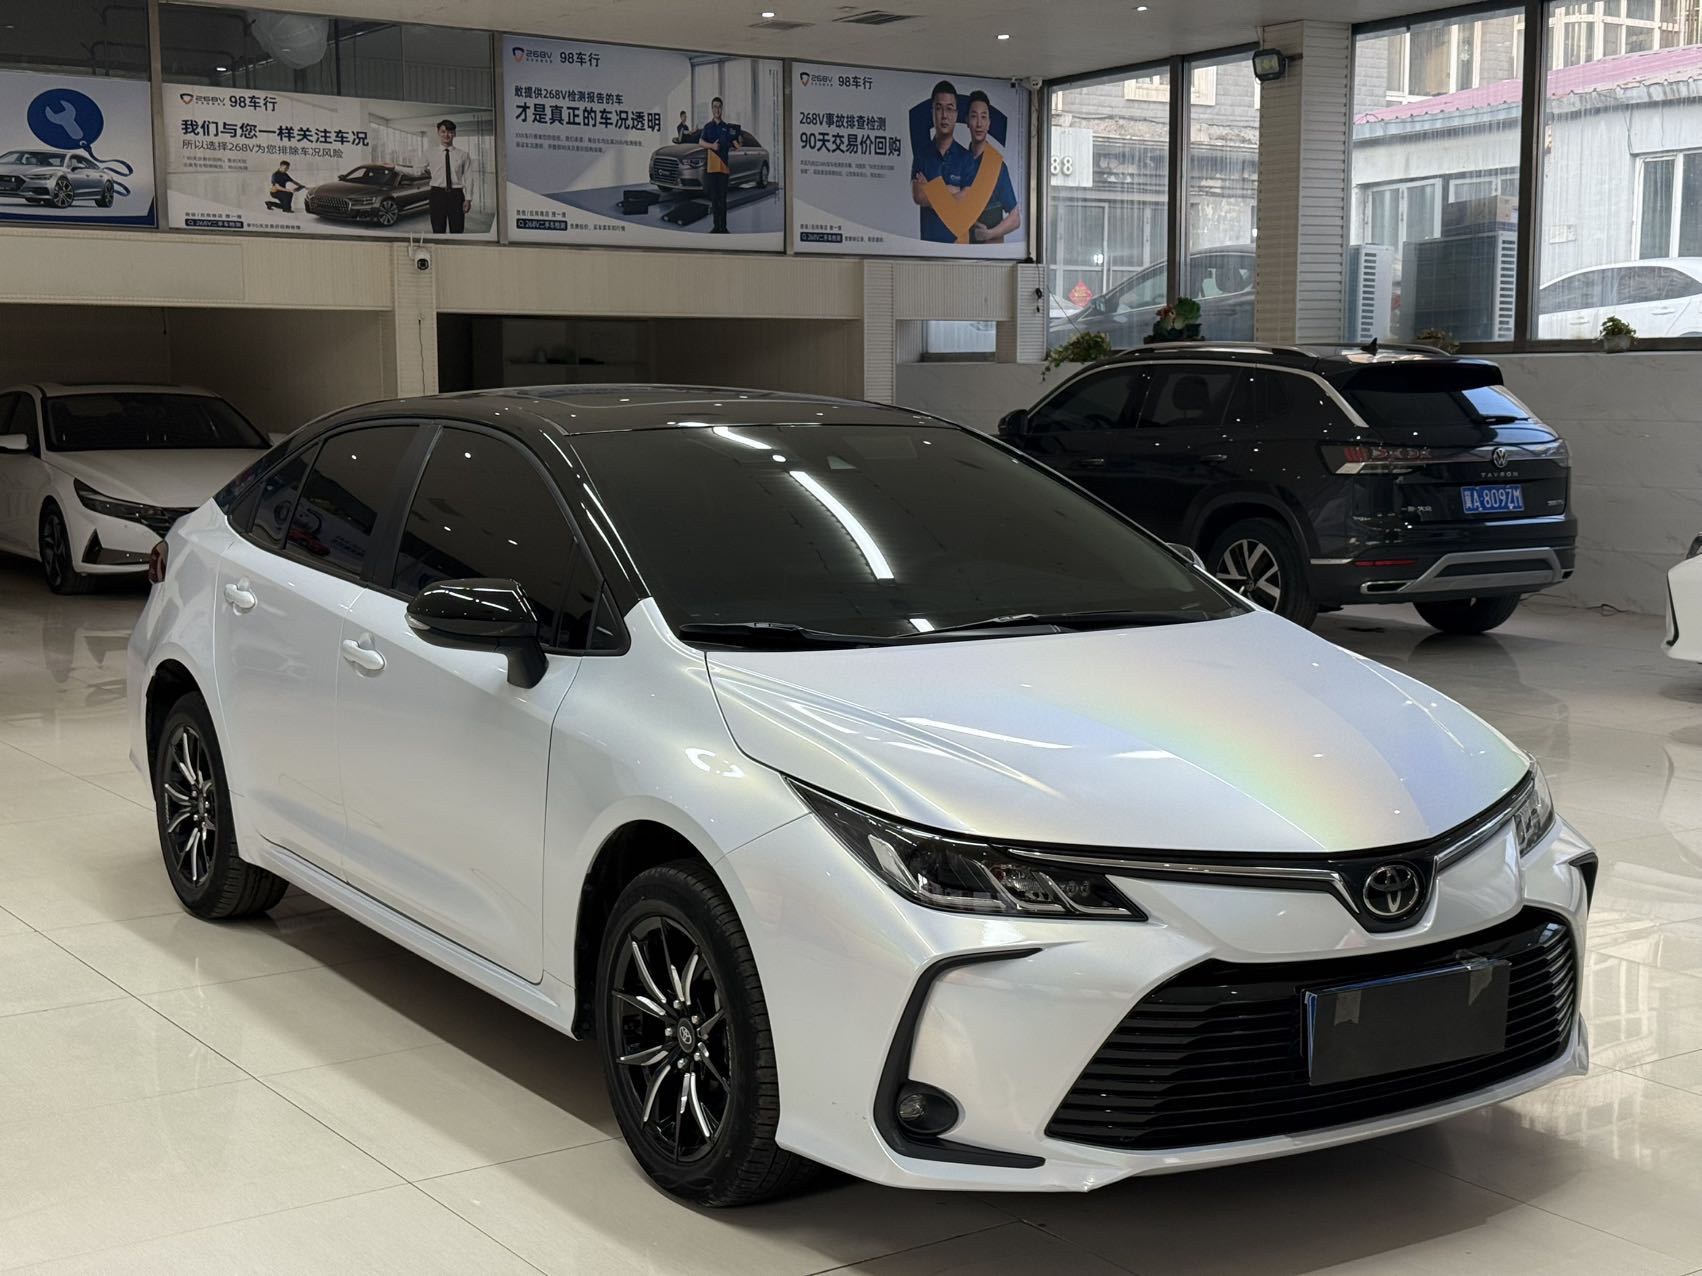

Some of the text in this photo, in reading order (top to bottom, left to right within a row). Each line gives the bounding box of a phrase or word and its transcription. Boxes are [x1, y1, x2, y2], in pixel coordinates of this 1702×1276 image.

[560, 51, 601, 68] 98车行
[838, 75, 873, 90] 98车行
[229, 95, 278, 112] 98车行
[514, 85, 624, 106] 敢提供268V检测报告的车
[515, 102, 661, 132] 才是真正的车况透明
[800, 112, 887, 132] 268V事故排查检测
[181, 119, 369, 147] 我们与您一样关注车况
[182, 139, 344, 159] 所以选择268V为您排除车况风险
[800, 132, 902, 157] 90天交易价回购
